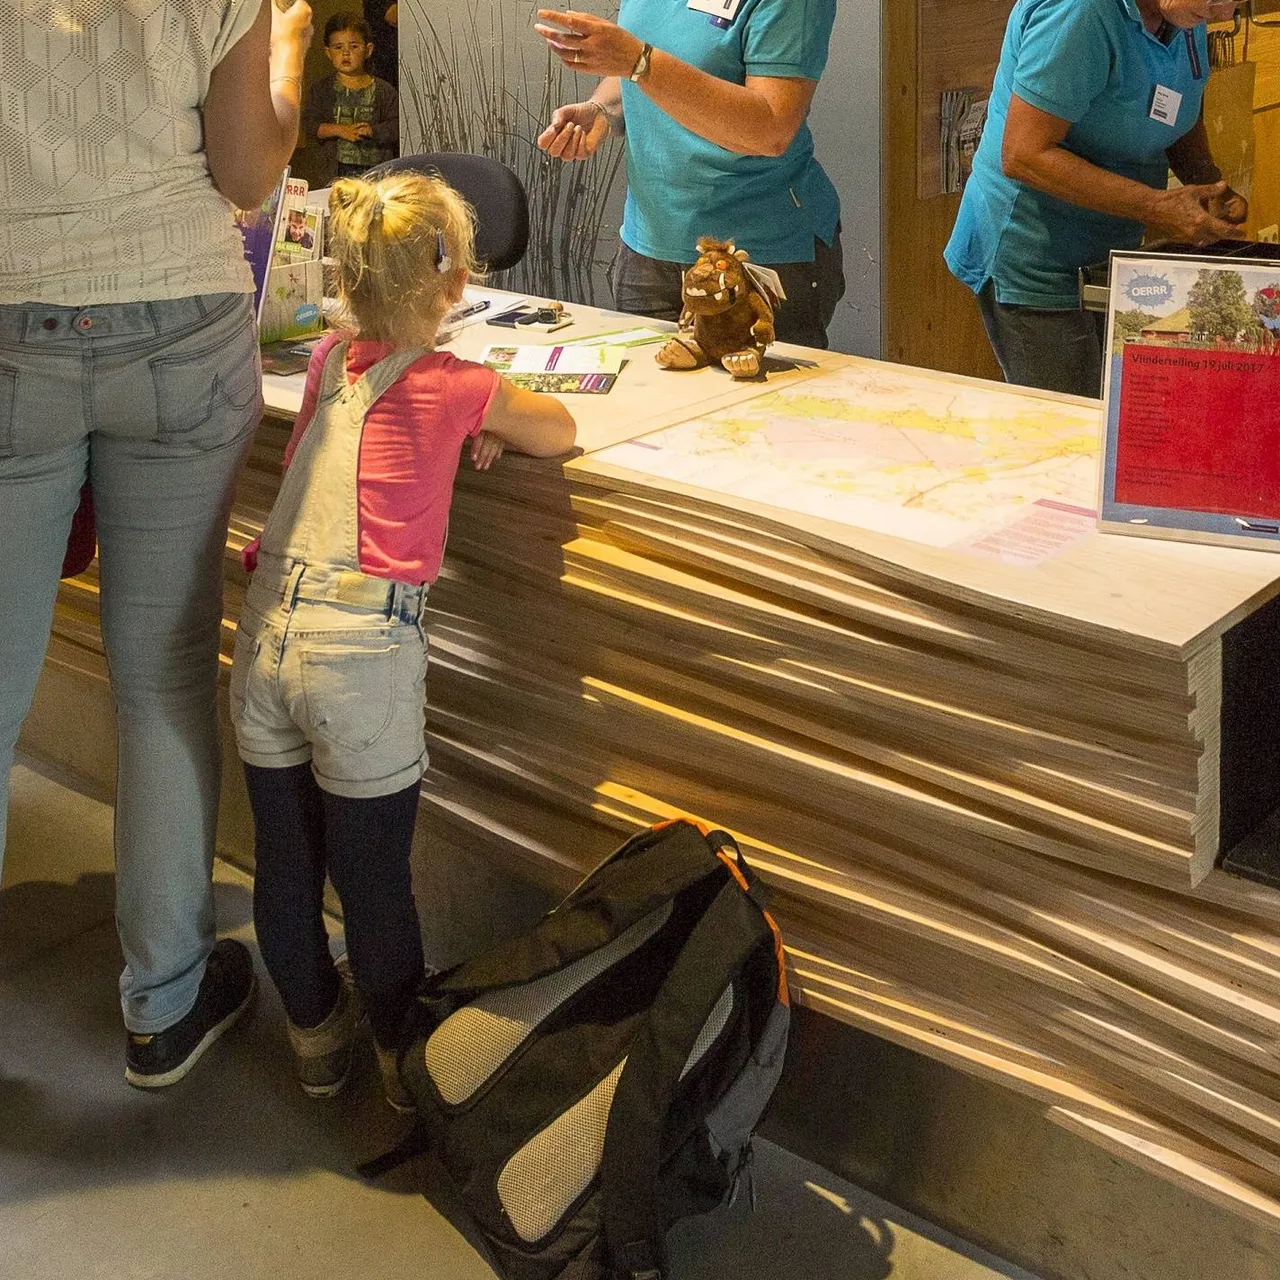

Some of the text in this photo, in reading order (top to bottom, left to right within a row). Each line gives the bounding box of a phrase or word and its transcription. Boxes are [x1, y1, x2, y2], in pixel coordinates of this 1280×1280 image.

[1131, 284, 1169, 297] OERRR
[1131, 354, 1201, 372] Vlindertelling
[1204, 359, 1216, 371] 19
[1236, 362, 1264, 373] 2017
